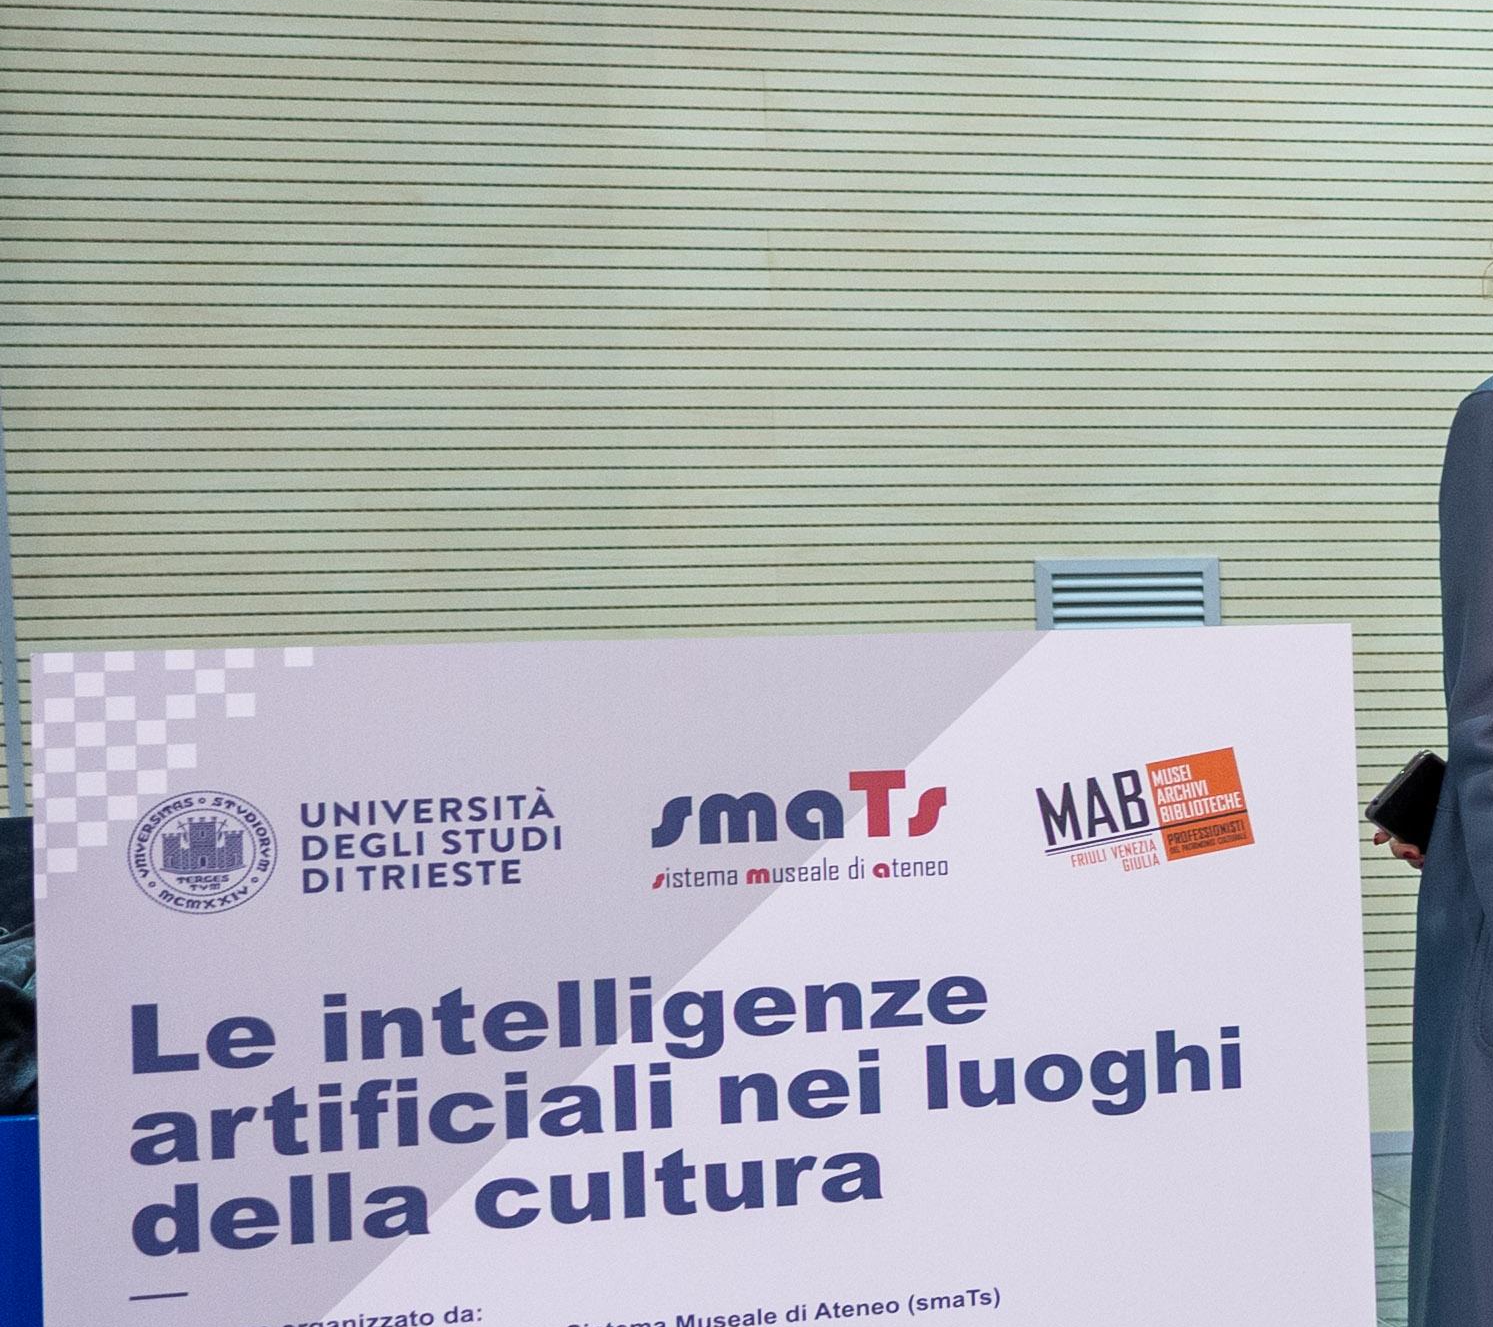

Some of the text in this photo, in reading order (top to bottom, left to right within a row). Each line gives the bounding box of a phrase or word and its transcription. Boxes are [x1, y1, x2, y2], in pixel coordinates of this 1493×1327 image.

[1151, 764, 1192, 787] MUSEI
[1157, 779, 1209, 806] ARCHIVI
[300, 786, 556, 828] UNIVERSITÀ
[651, 769, 947, 848] smaTs
[1035, 769, 1150, 845] MAB
[1160, 791, 1243, 823] BIBLIOTECHE
[302, 825, 563, 862] DEGLI STUDI
[1070, 848, 1107, 868] FRIULI
[1111, 839, 1157, 859] VENEZIA
[302, 859, 522, 894] DI TRIESTE
[652, 856, 949, 889] sistema museale di ateneo
[1122, 853, 1161, 873] GIULIA
[130, 975, 989, 1075] Le intelligenze
[130, 1026, 1244, 1167] artificiali nei luoghi
[131, 1149, 884, 1258] della cultura
[444, 1306, 483, 1325] da:
[785, 1304, 807, 1323] di
[815, 1298, 900, 1320] Ateneo
[908, 1287, 1001, 1316] (smaTs)
